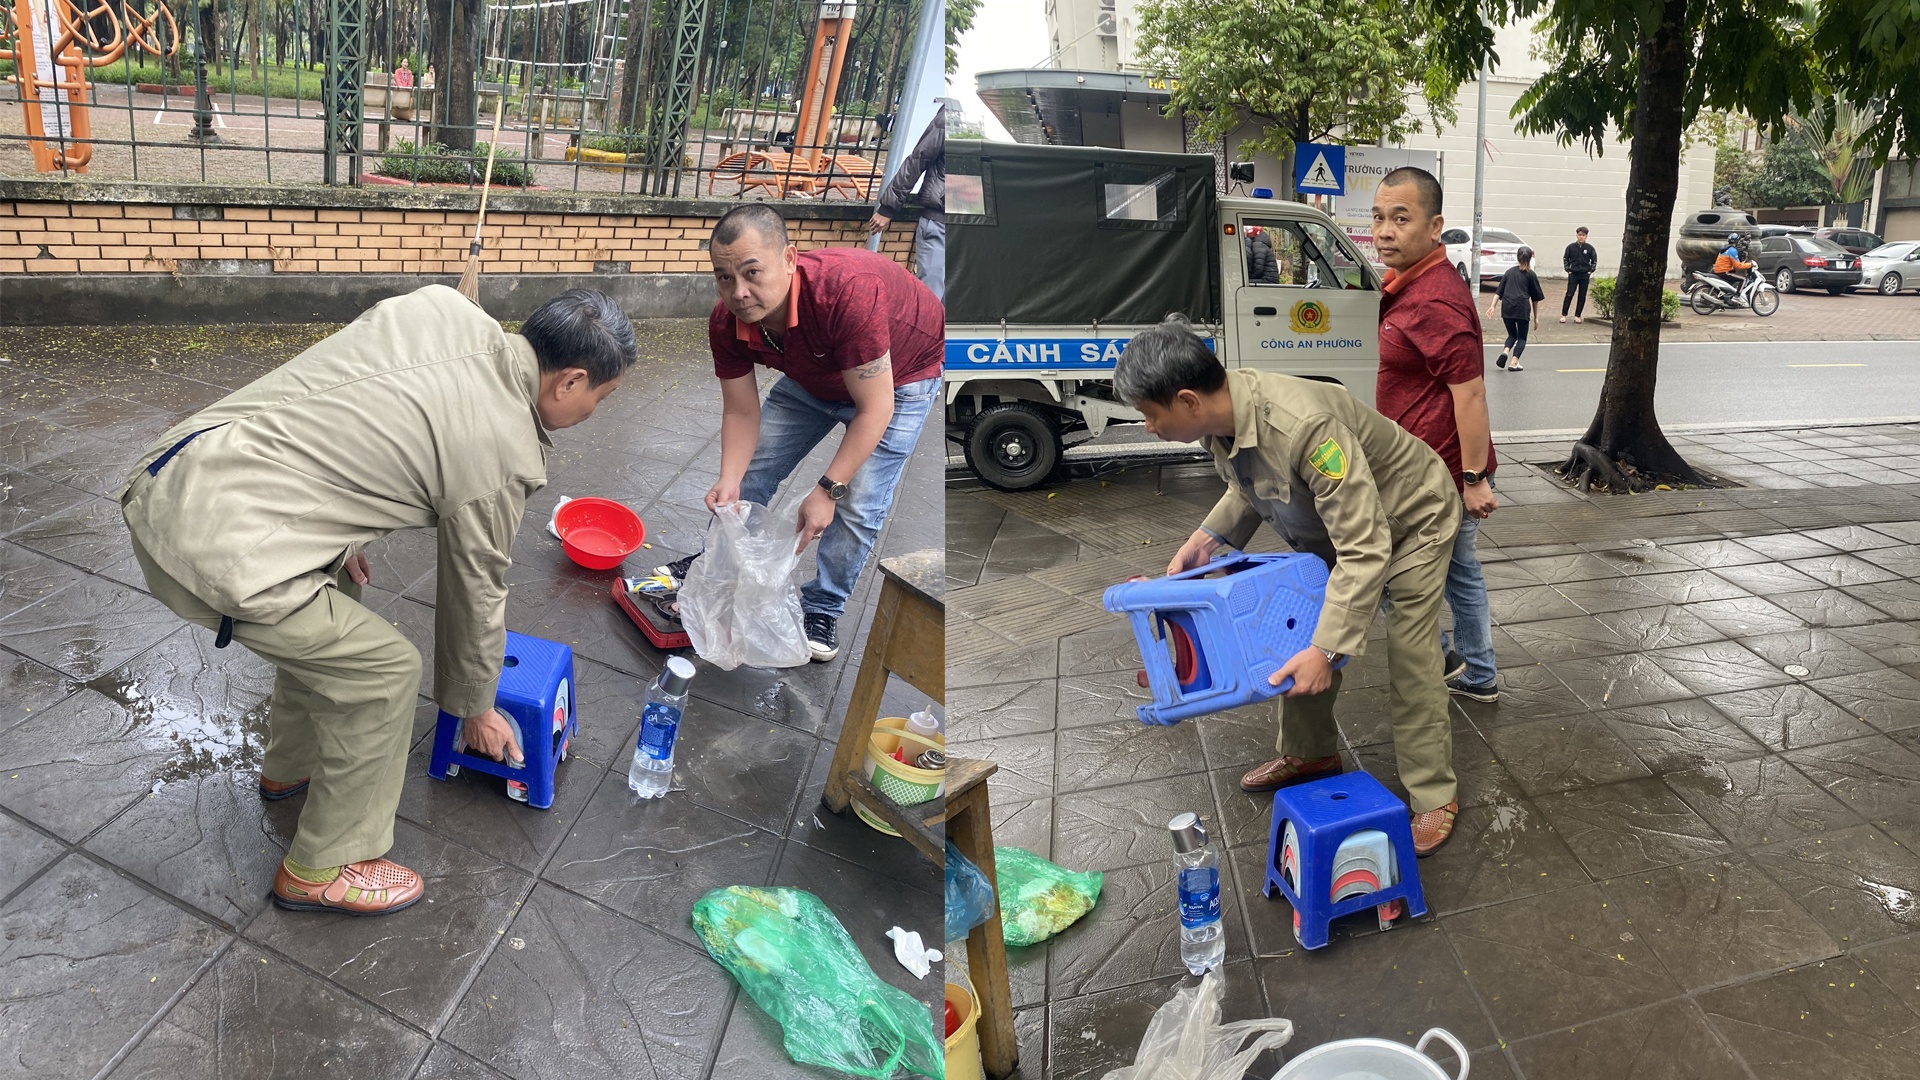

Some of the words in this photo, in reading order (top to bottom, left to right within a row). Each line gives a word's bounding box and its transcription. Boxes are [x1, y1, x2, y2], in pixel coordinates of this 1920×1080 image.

[966, 338, 1061, 363] CẢNH
[1260, 338, 1294, 349] CÔNG
[1297, 340, 1313, 348] AN
[1316, 337, 1363, 348] PHƯỜNG
